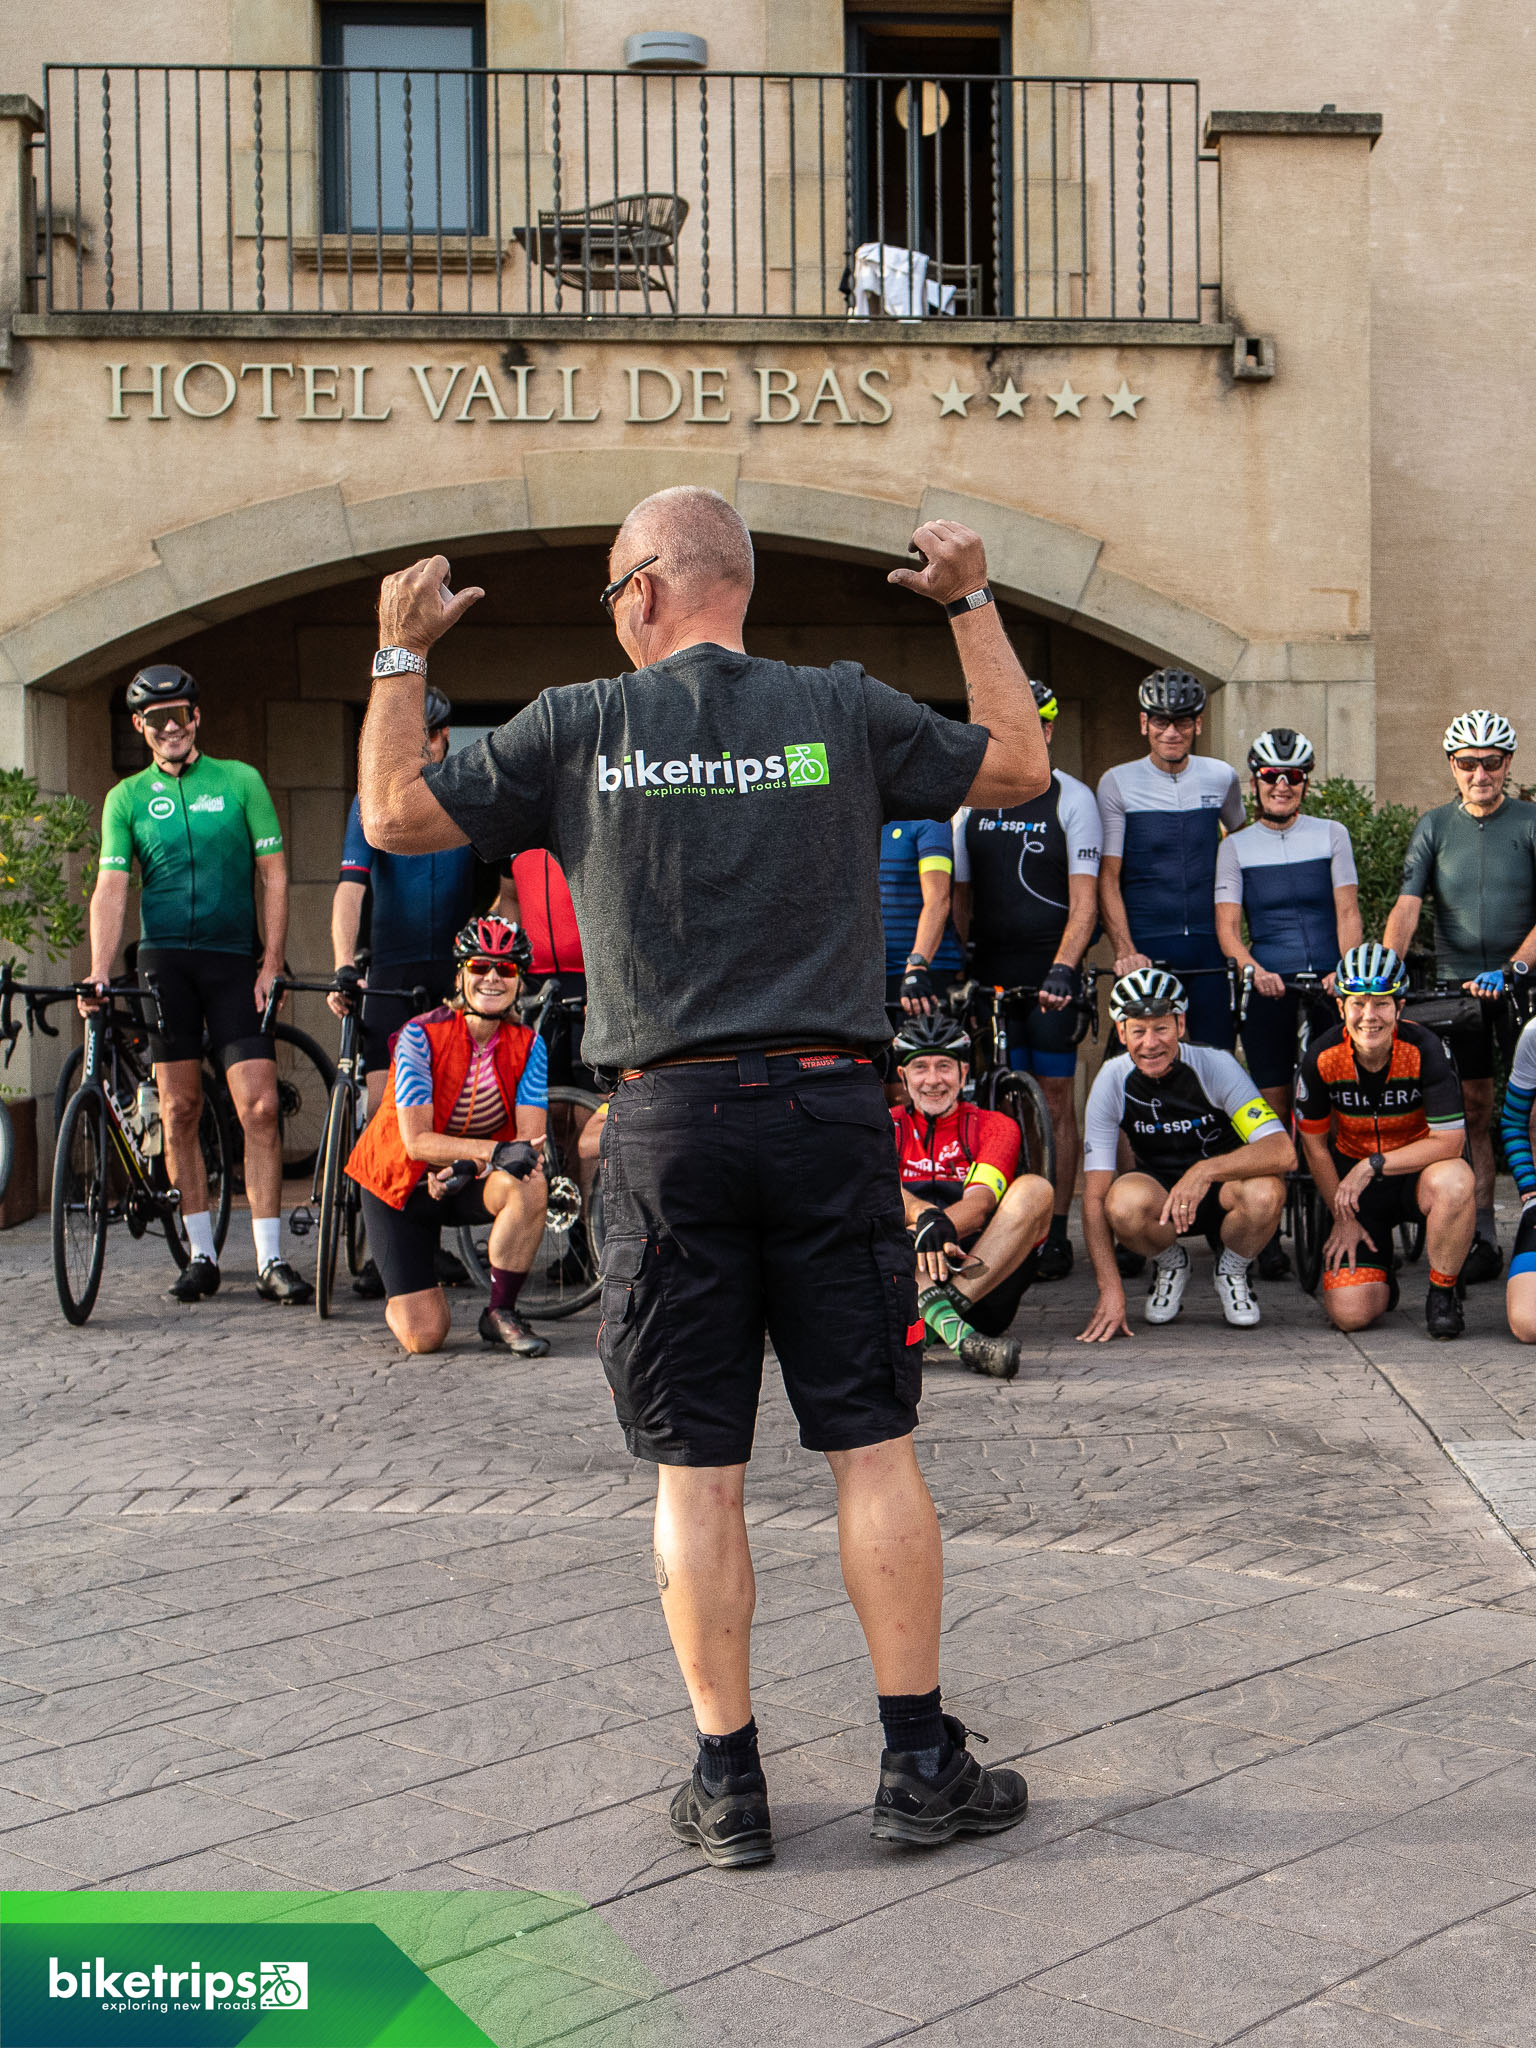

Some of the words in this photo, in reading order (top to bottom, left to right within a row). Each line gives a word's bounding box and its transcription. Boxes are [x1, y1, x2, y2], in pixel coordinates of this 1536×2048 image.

[104, 360, 392, 421] HOTEL
[409, 364, 600, 422] VALL
[623, 366, 732, 424] DE
[753, 367, 894, 426] BAS
[597, 750, 785, 793] biketrips
[645, 784, 706, 797] exploring
[711, 786, 736, 795] new
[751, 779, 787, 792] roads
[802, 1059, 835, 1069] STRAUSS
